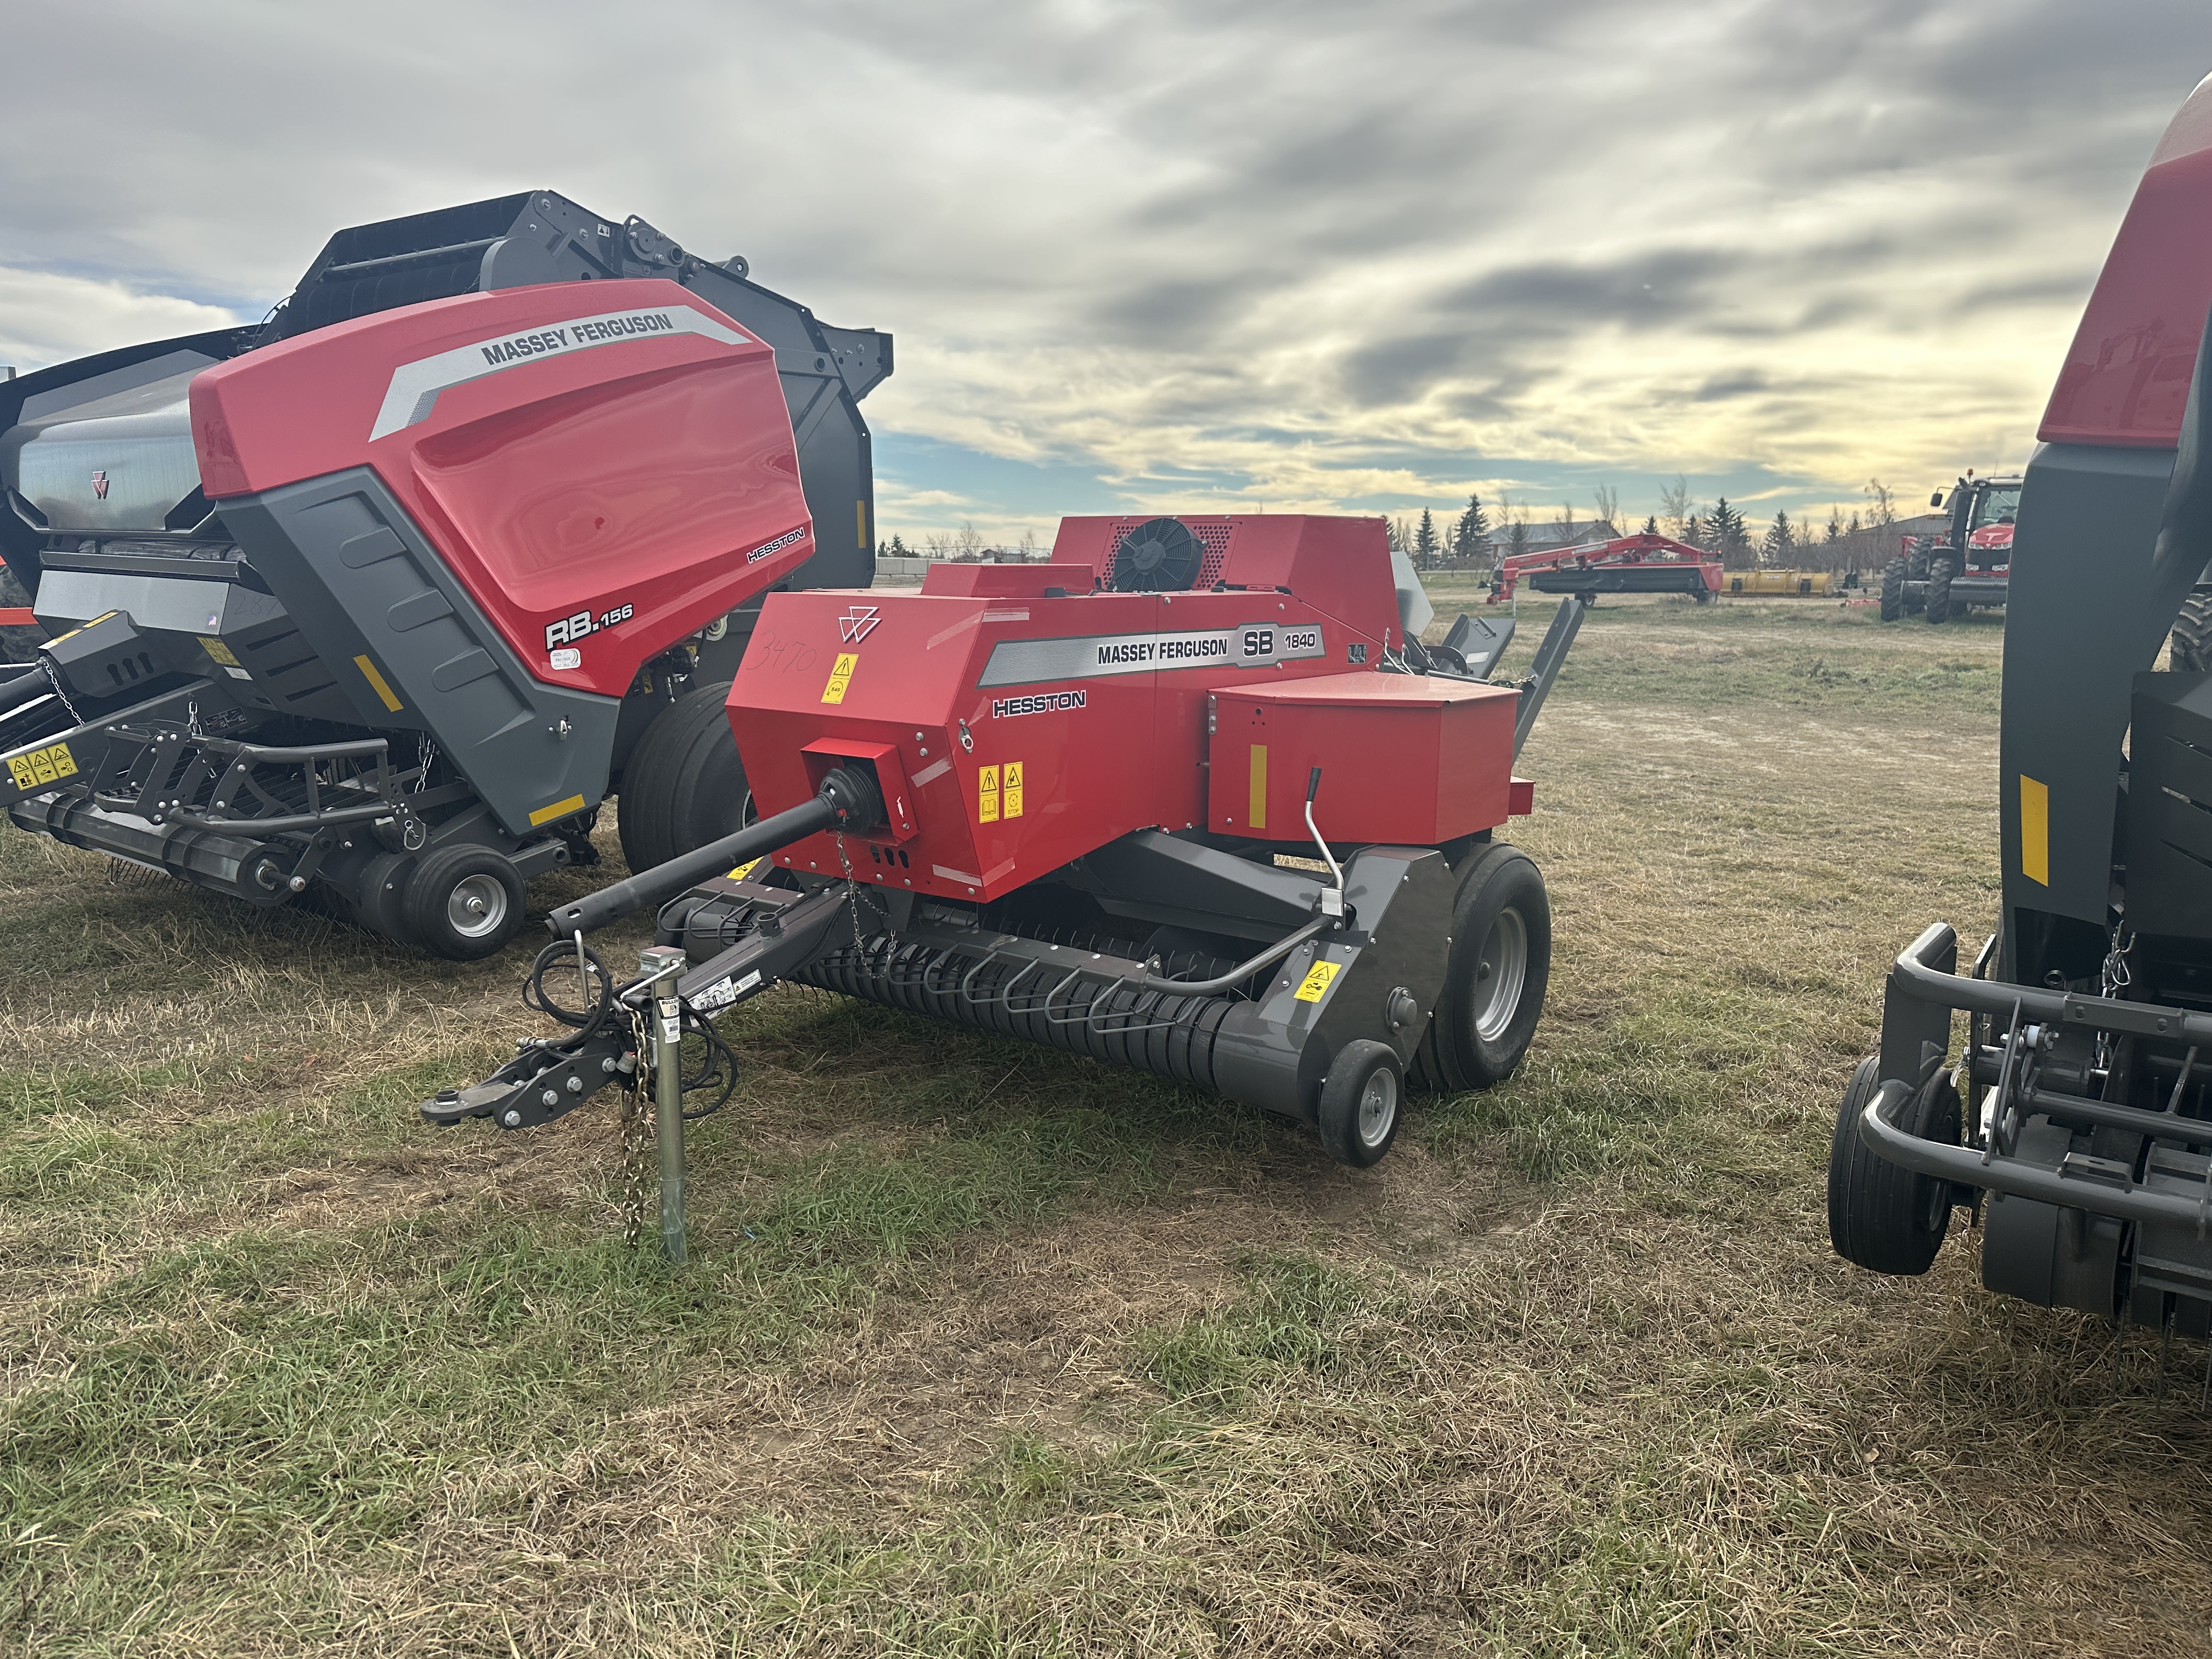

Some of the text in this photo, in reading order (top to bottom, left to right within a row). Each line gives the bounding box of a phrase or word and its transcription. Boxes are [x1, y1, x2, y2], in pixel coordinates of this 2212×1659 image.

[481, 313, 674, 365] MASSEY FERGUSON
[747, 527, 806, 563] HESSTON
[746, 630, 817, 673] 3470
[1097, 628, 1317, 666] MASSEY FERGUSON SB 1840
[992, 690, 1087, 719] HESSTON
